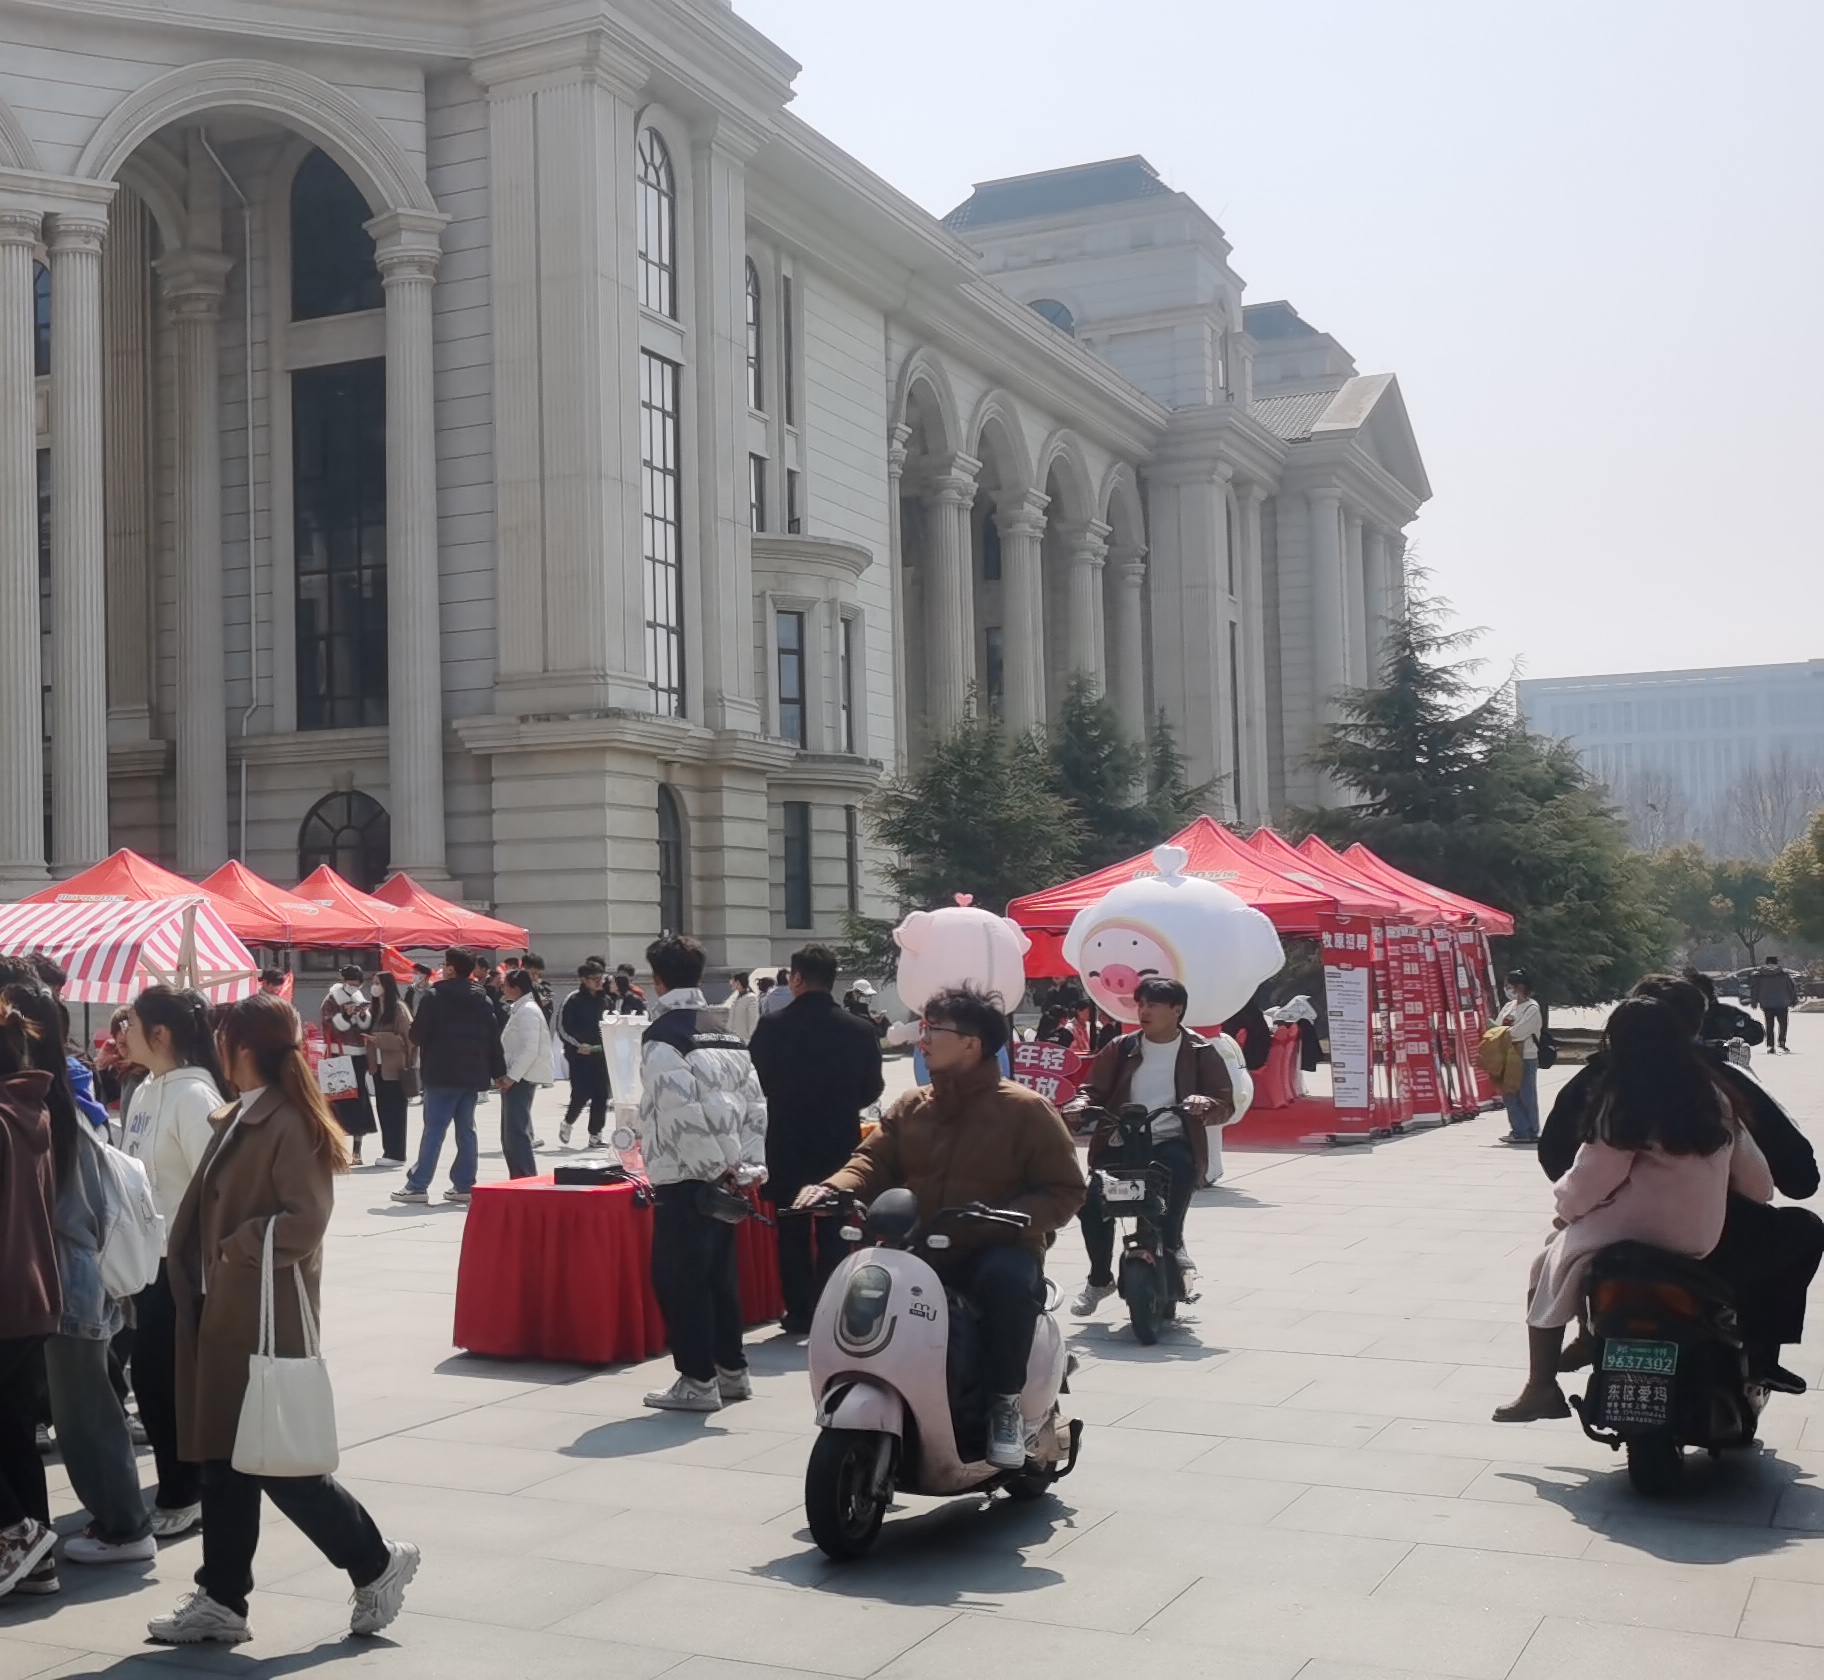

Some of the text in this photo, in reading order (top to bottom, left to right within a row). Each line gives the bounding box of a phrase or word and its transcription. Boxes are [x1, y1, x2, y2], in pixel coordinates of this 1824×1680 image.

[1322, 932, 1368, 951] 牧原招聘
[1015, 1045, 1065, 1070] 年轻
